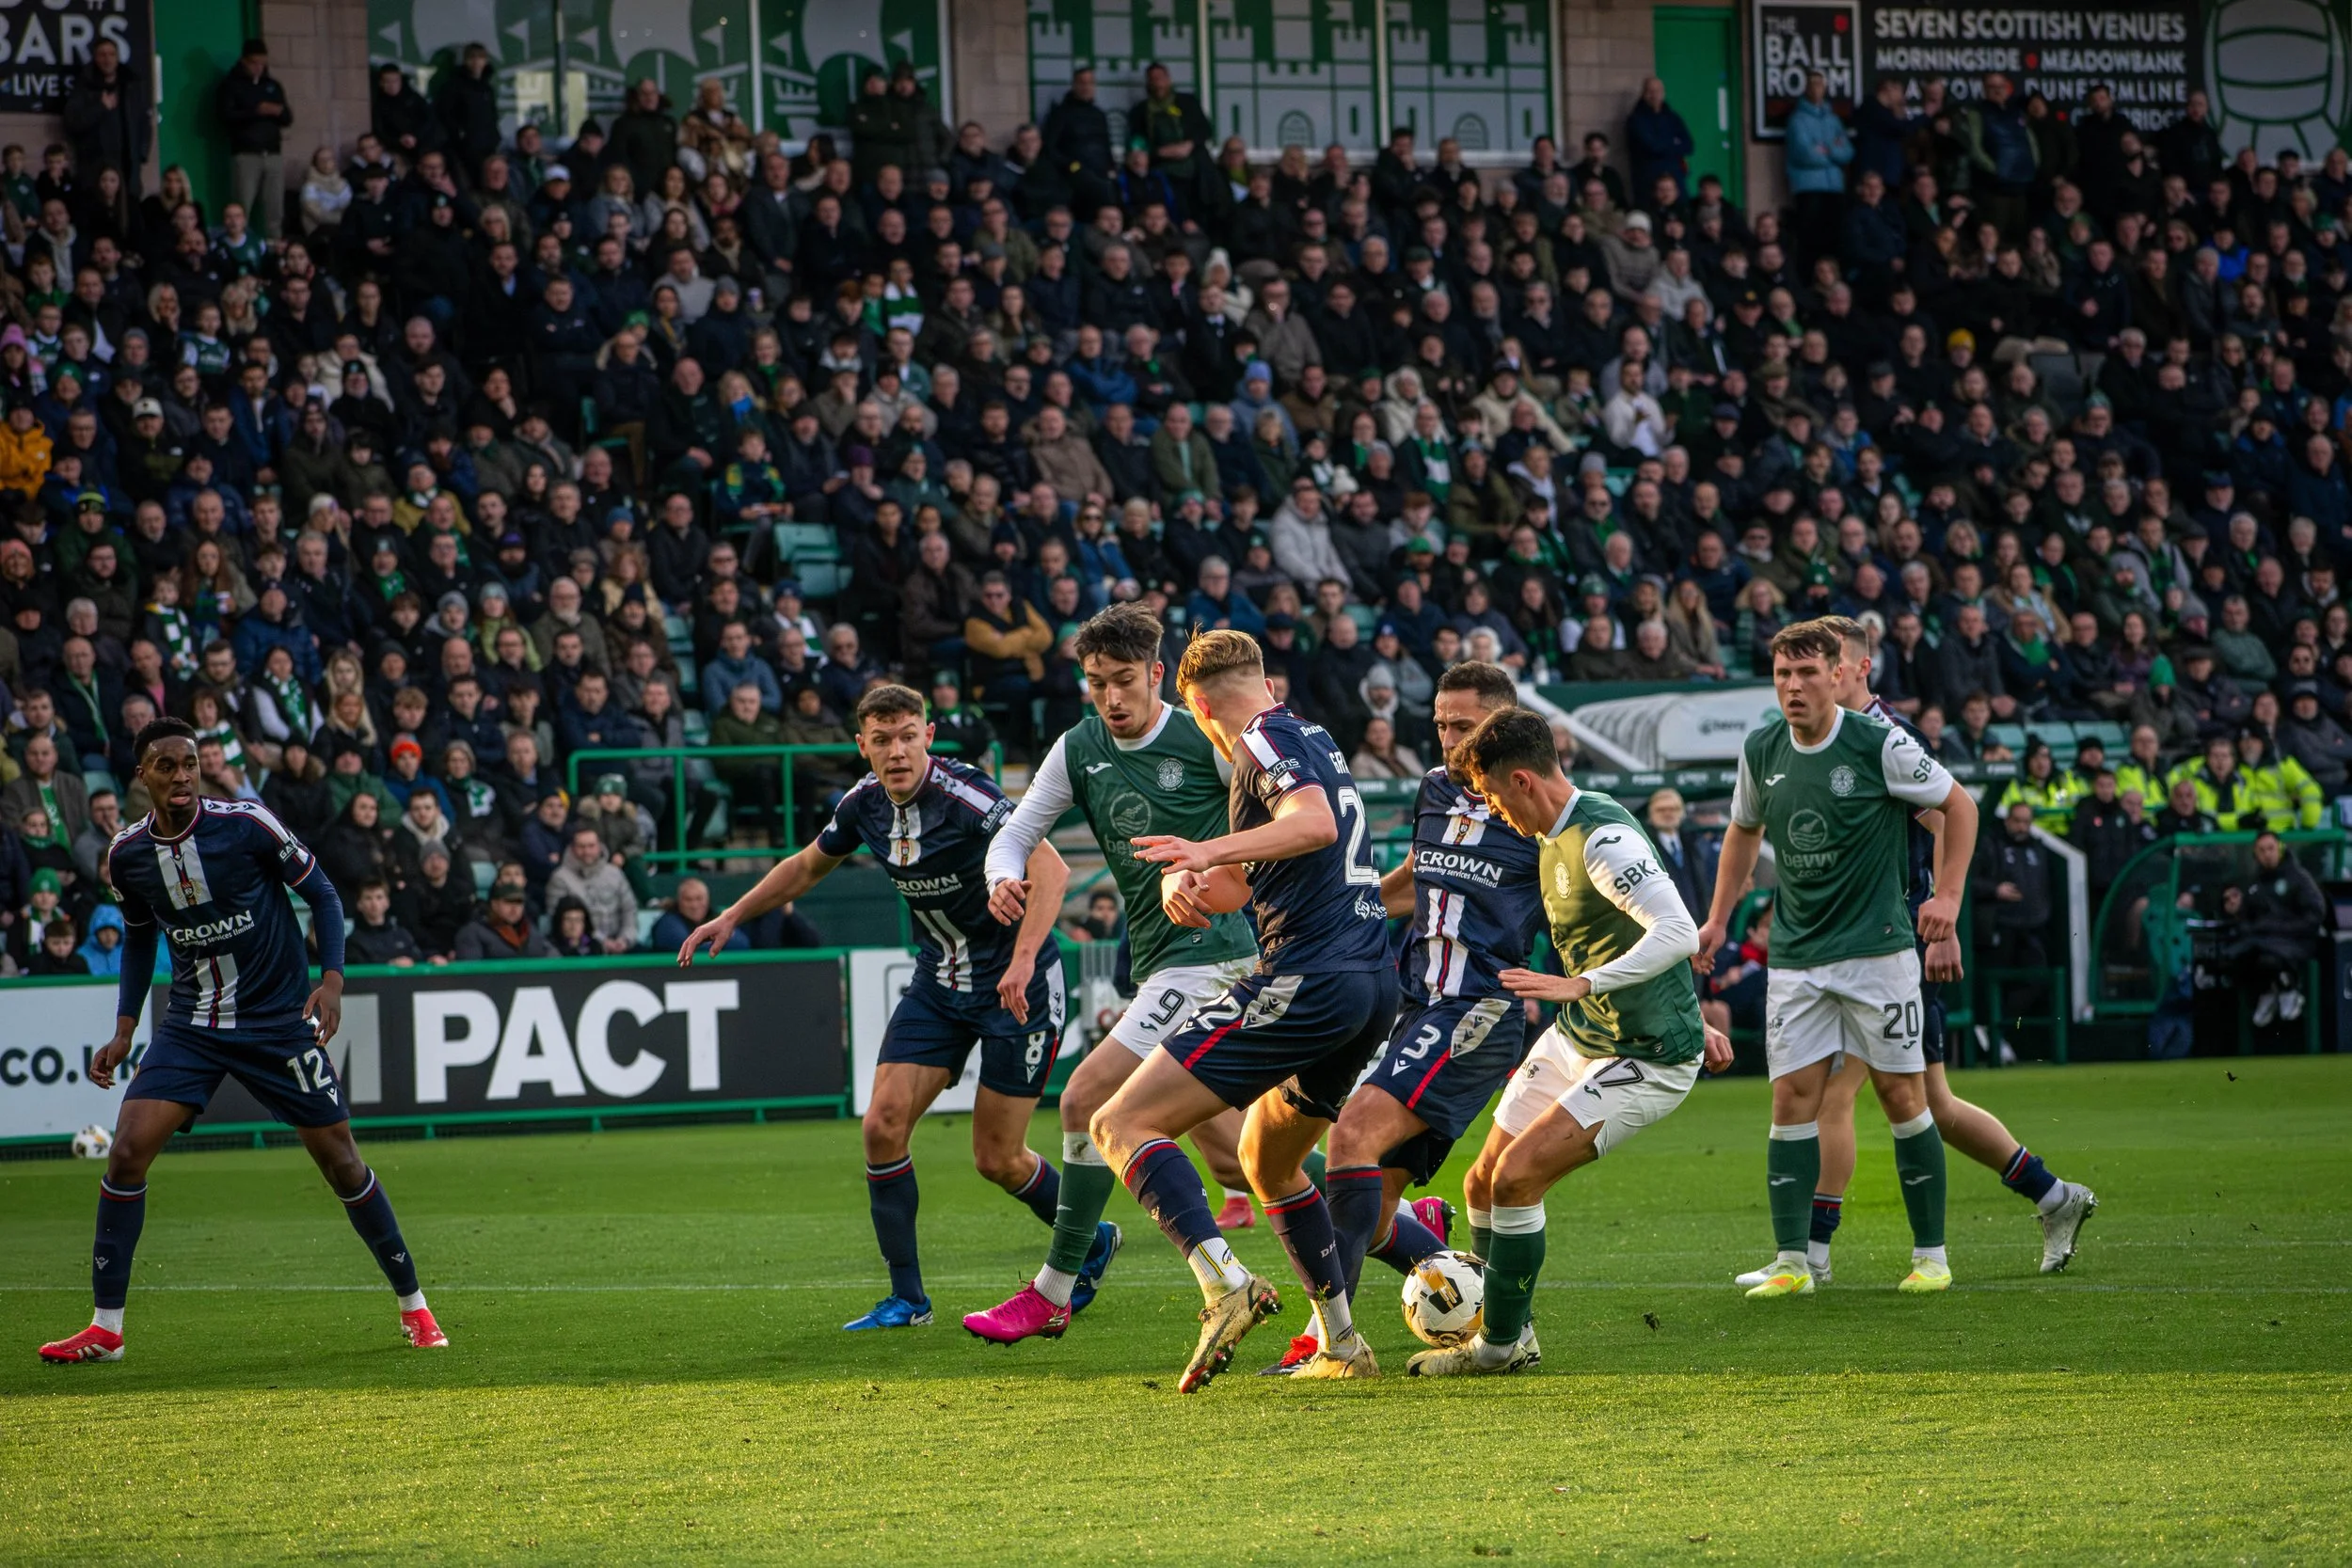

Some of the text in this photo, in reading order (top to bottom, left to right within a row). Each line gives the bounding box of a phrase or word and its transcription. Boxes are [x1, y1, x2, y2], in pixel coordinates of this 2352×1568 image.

[0, 11, 131, 65] BARS
[1767, 17, 1796, 34] THE
[1875, 9, 2186, 42] SEVEN SCOTTISH VENUES
[1766, 34, 1850, 66] BALL
[1876, 48, 2186, 73] MORNINGSIDE MEADOWBANK
[13, 73, 59, 97] LIVE
[1914, 758, 1932, 783] SB
[1338, 786, 1381, 887] 2
[1420, 850, 1503, 881] CROWN
[1446, 869, 1470, 879] services
[1471, 874, 1498, 888] limited
[172, 909, 253, 943] CROWN
[1148, 989, 1184, 1025] 9
[1883, 1001, 1919, 1038] 20
[1025, 1031, 1046, 1065] 8
[1400, 1023, 1441, 1059] 3
[286, 1048, 333, 1093] 12
